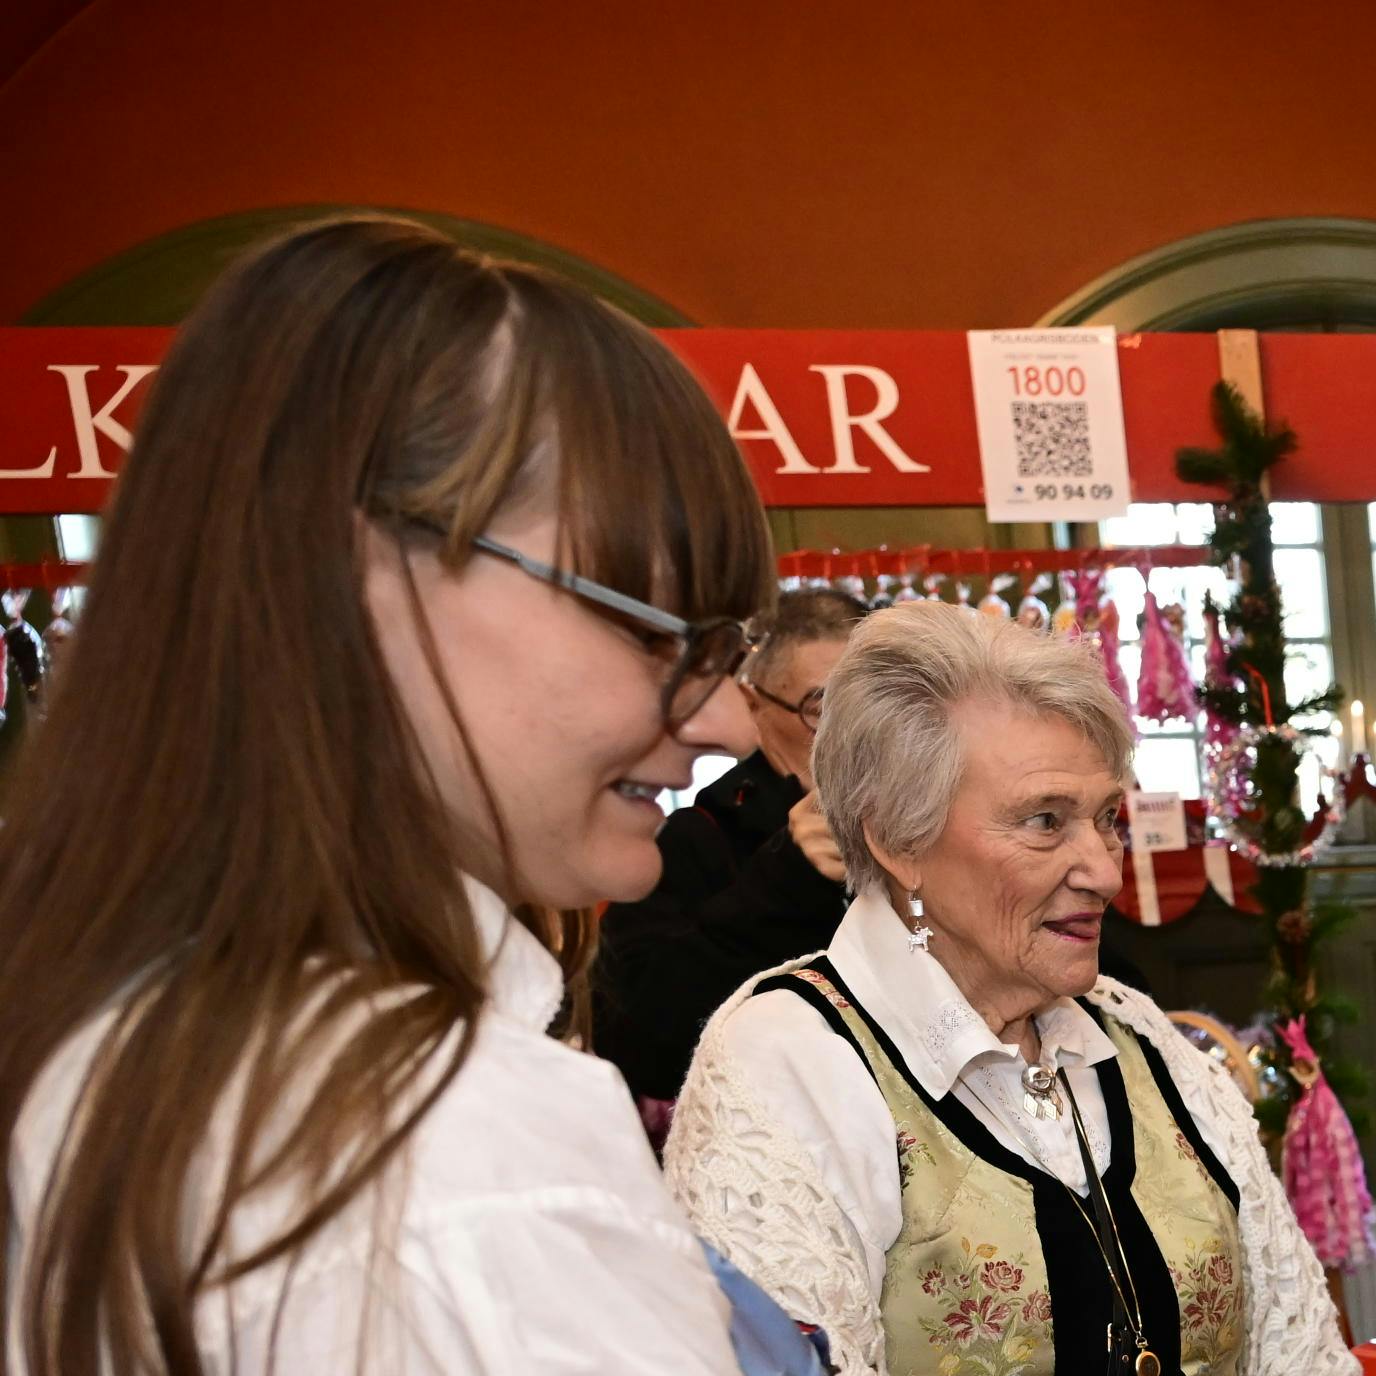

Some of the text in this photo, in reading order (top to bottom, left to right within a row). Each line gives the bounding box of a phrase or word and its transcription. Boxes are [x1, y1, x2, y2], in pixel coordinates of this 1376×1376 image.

[1007, 365, 1086, 396] 1800
[1034, 483, 1114, 501] 90 94 09
